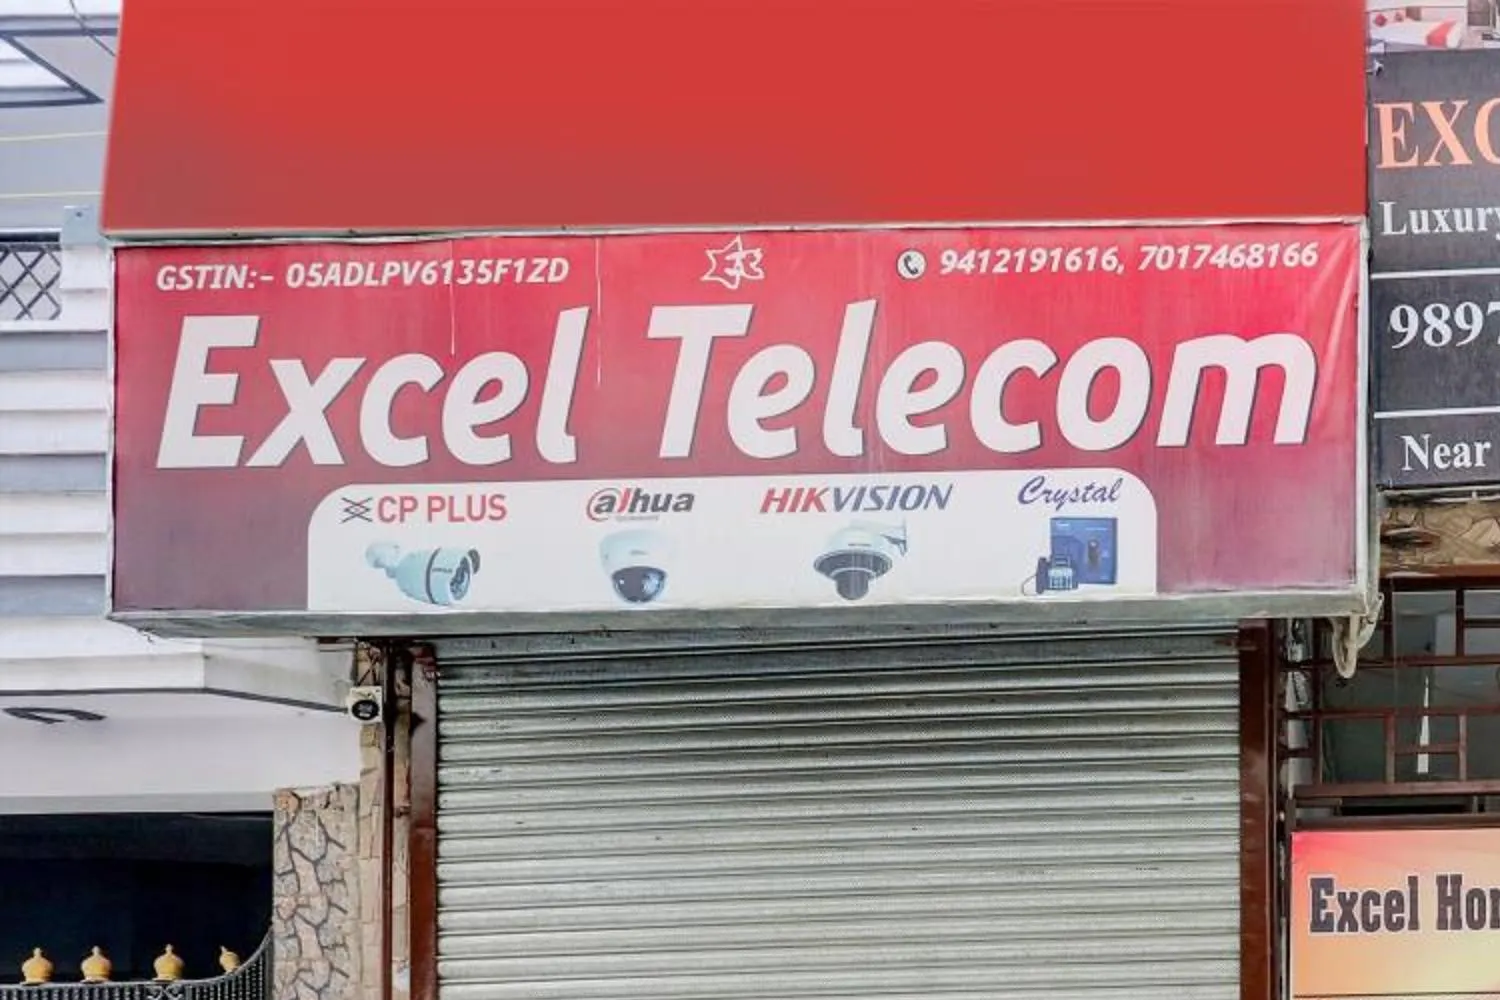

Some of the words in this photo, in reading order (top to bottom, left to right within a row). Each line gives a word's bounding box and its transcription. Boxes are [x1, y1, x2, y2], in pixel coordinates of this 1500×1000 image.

[938, 247, 1125, 276] 9412191616,
[1138, 243, 1318, 271] 7017468166
[156, 263, 275, 291] GSTIN:-
[156, 306, 590, 469] Excel
[647, 299, 1317, 461] Telecom
[1402, 434, 1491, 470] Near
[378, 495, 418, 523] CP
[427, 493, 507, 523] PLUS
[760, 483, 953, 513] HIKVISION
[1017, 476, 1123, 510] Crystal
[1309, 875, 1419, 932] Excel
